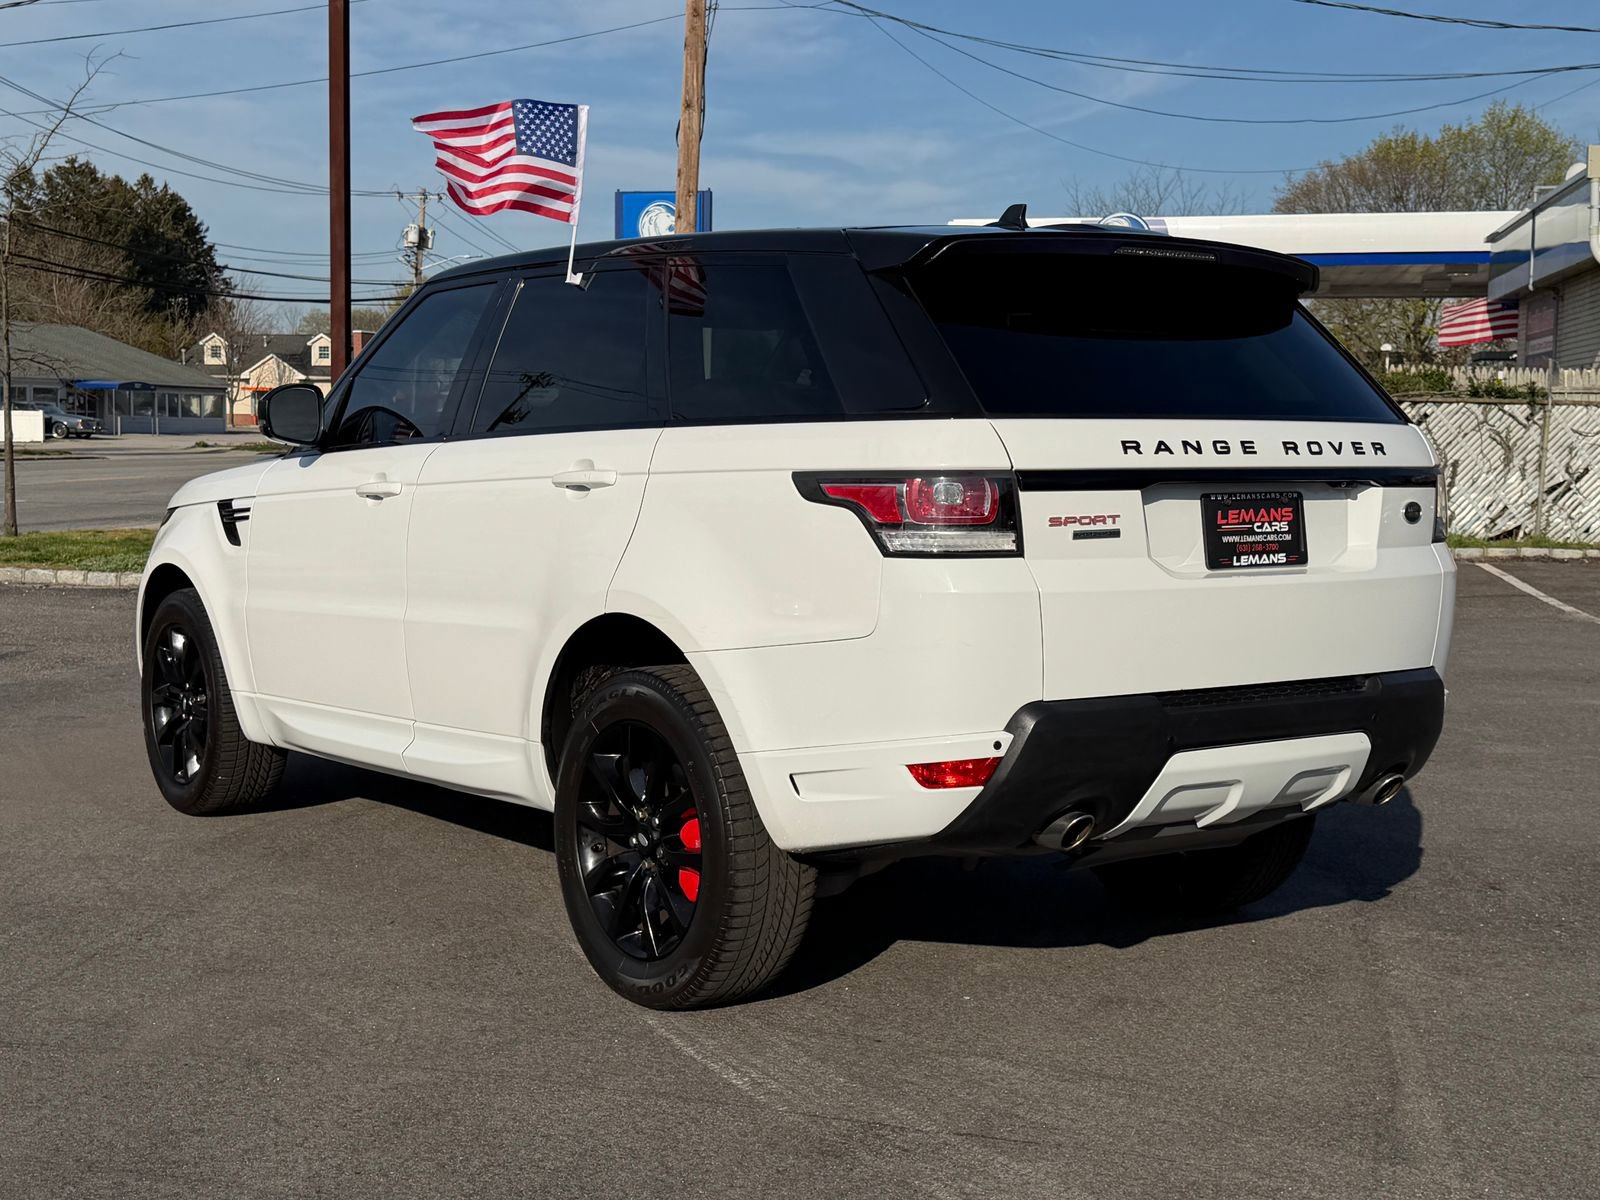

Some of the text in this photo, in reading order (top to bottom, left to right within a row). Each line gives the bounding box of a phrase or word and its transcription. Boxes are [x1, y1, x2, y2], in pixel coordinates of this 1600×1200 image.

[1120, 439, 1387, 456] RANGE ROVER
[1048, 514, 1121, 527] SPORT
[1217, 507, 1294, 525] LEMANS
[1253, 521, 1289, 532] CARS
[1221, 533, 1292, 543] WWW.LEMANSCARS.COM
[1233, 553, 1287, 566] LEMANS
